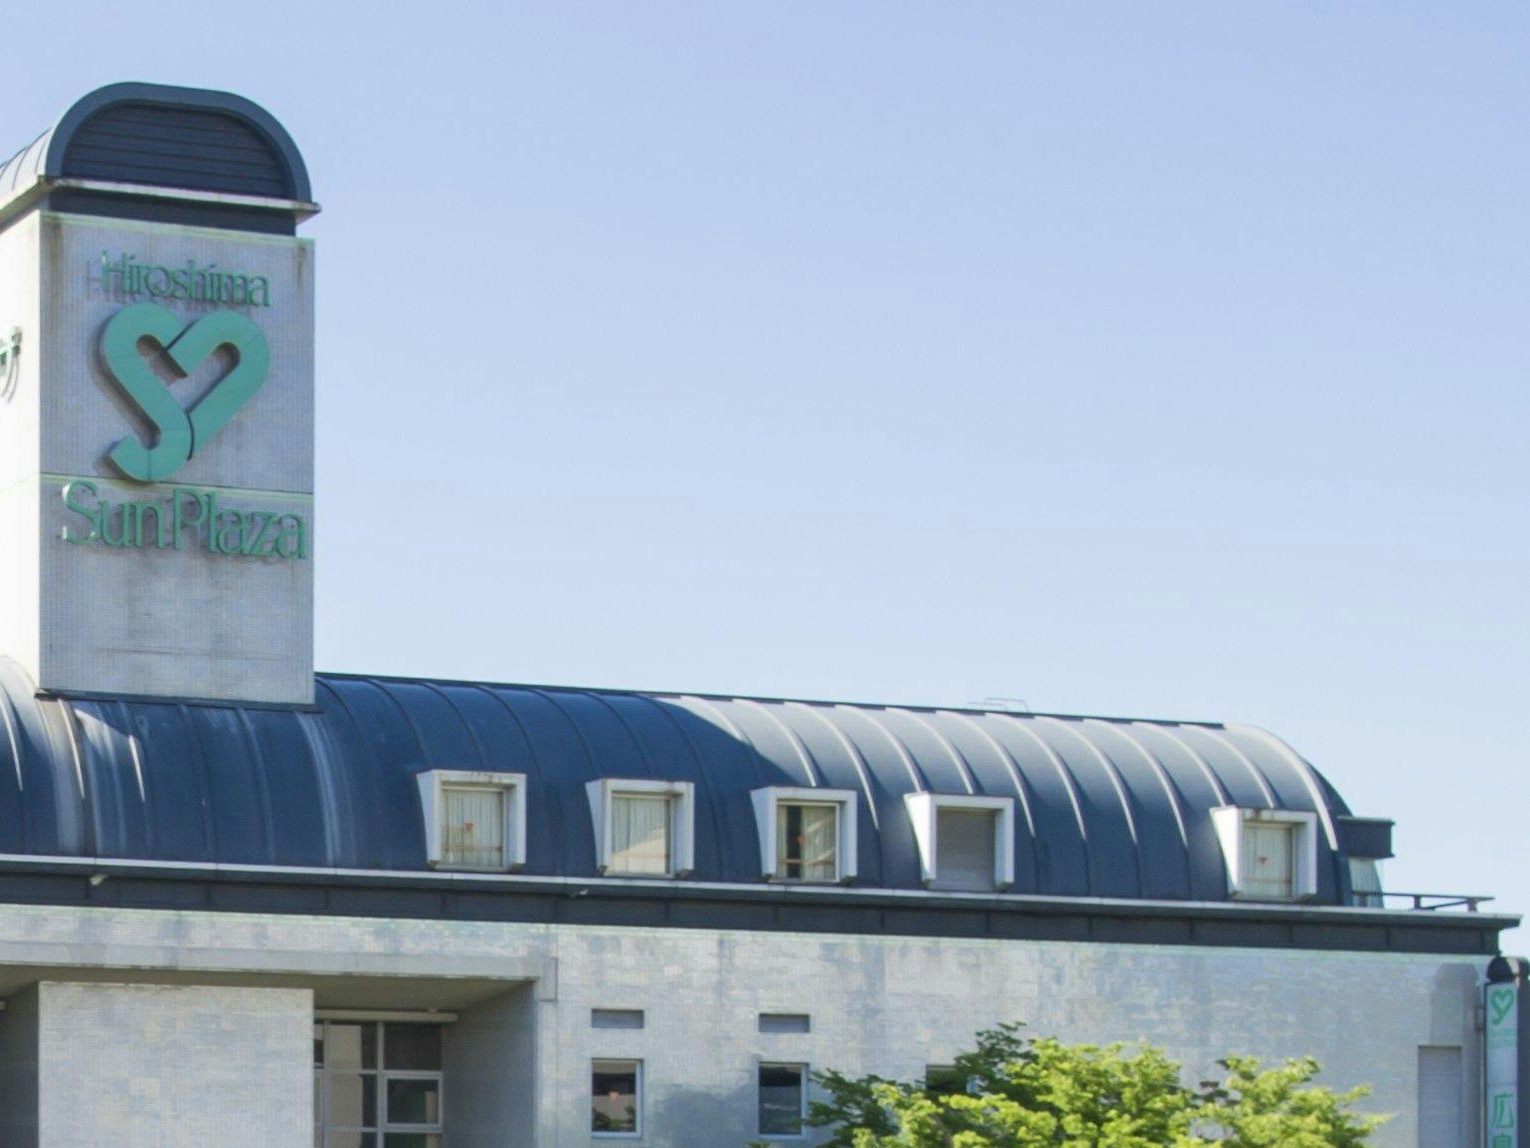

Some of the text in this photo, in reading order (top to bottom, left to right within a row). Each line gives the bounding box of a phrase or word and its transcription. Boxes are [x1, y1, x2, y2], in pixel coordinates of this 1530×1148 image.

[102, 250, 270, 307] Hiroshima
[61, 480, 307, 560] Sun Plaza
